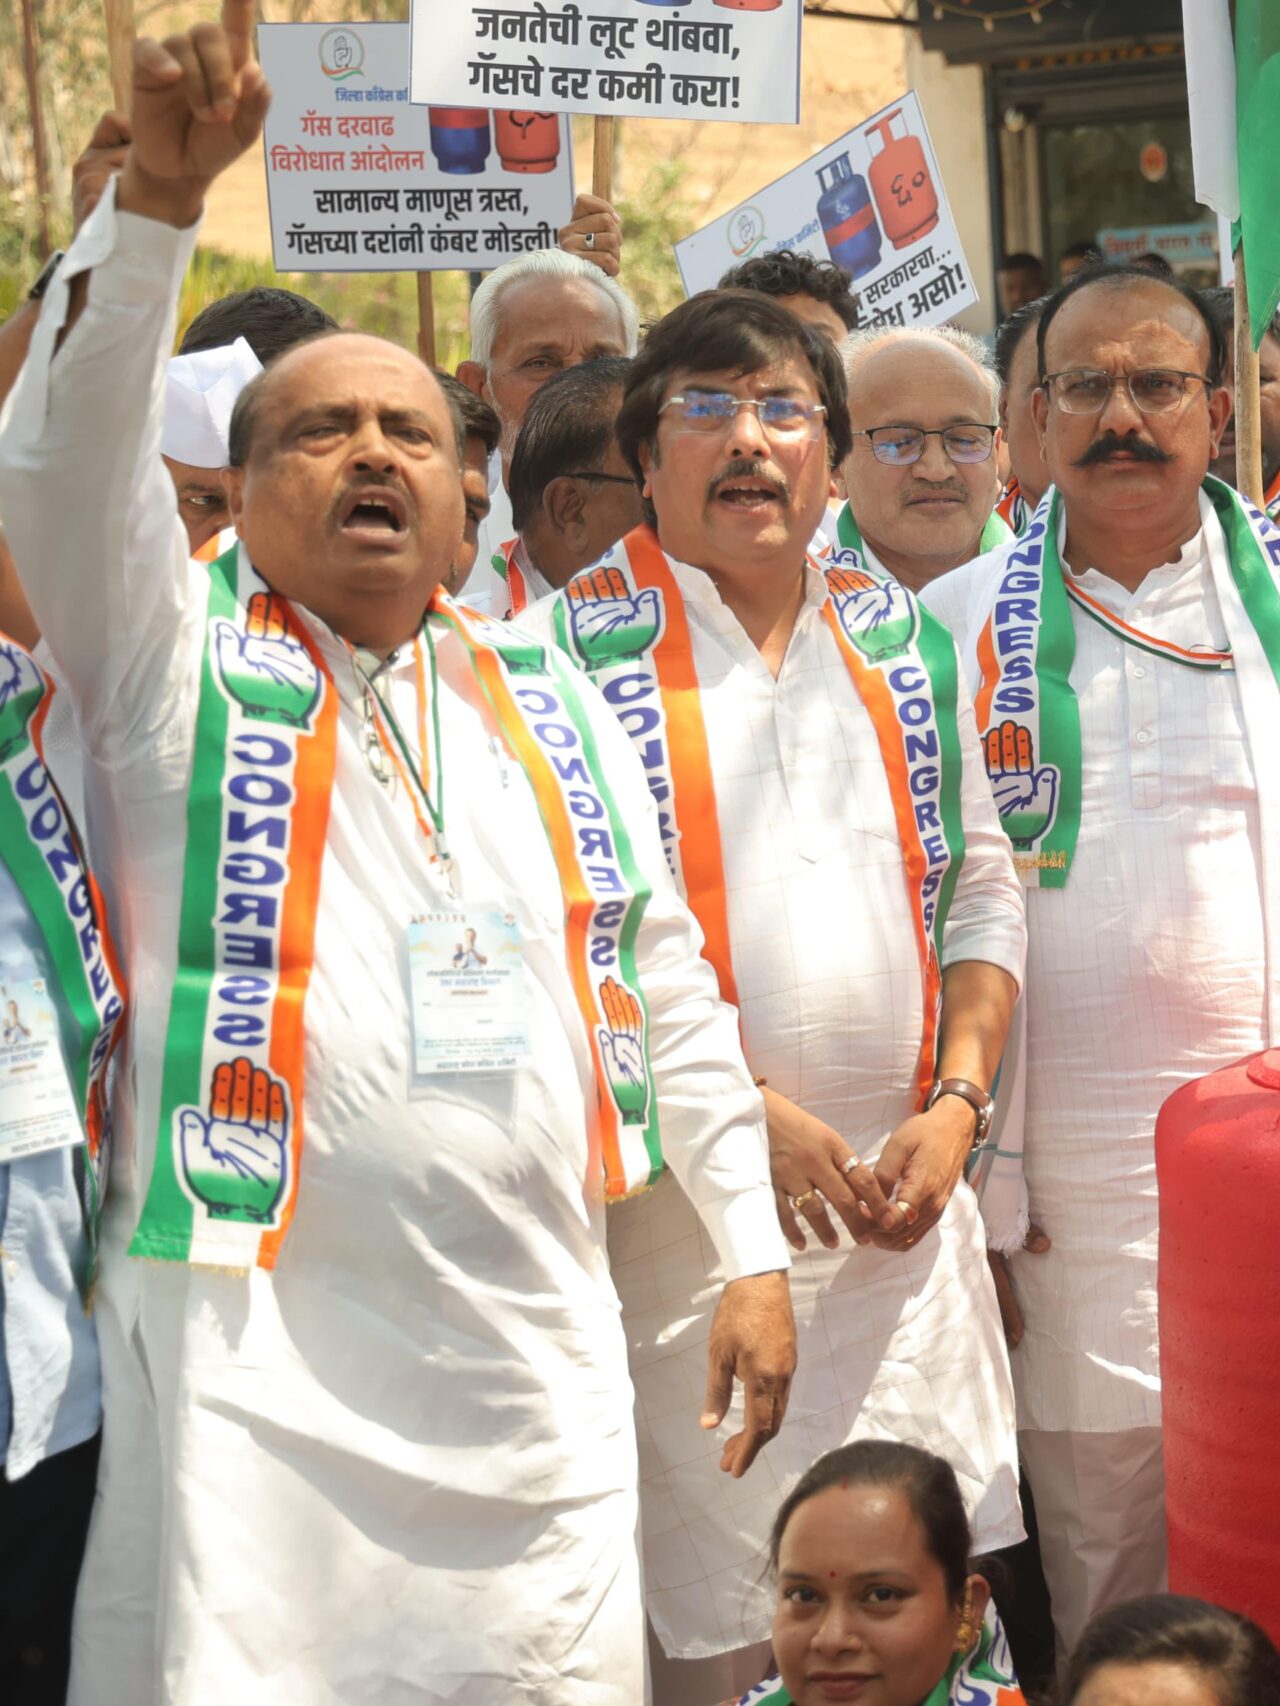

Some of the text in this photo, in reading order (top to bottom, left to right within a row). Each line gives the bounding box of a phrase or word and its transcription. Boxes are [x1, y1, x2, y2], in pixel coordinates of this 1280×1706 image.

[472, 2, 740, 60] जनतेची लूट थांबवा,
[467, 52, 740, 108] गॅसचे दर कमी करा!
[301, 110, 395, 138] गॅस दरवाढ
[270, 144, 425, 173] विरोधात आंदोलन
[313, 188, 529, 221] सामान्य माणूस त्रस्त,
[286, 223, 357, 255] गॅसच्या
[361, 222, 424, 254] दरांनी
[427, 223, 478, 254] कंबर
[908, 262, 967, 319] असो!
[888, 666, 950, 934] CONGRESS
